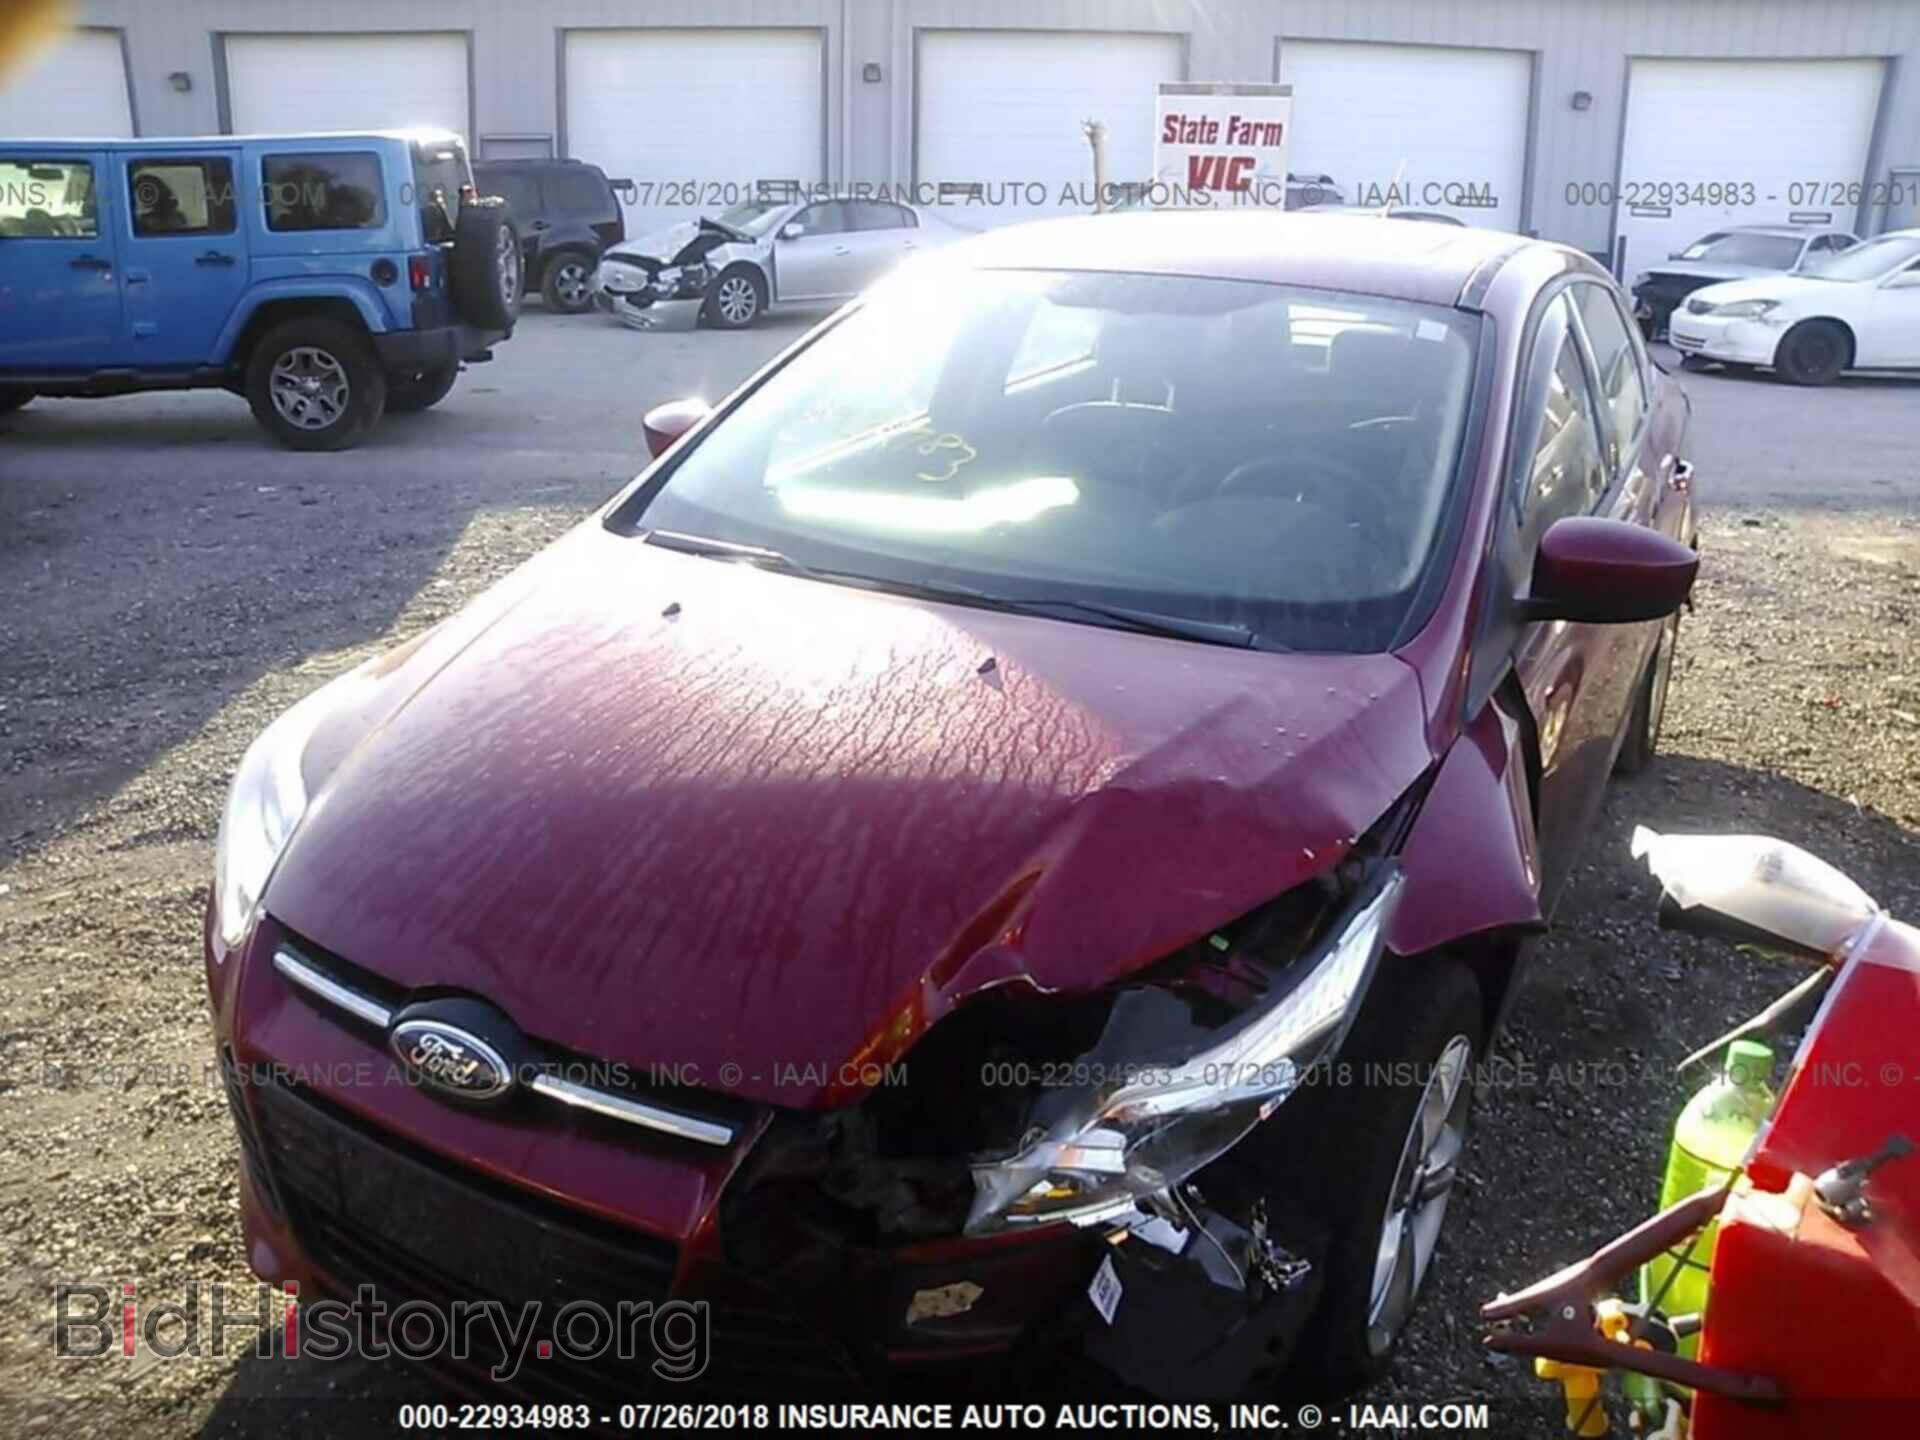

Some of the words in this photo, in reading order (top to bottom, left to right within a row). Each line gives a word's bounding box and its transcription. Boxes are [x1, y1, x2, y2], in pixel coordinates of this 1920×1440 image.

[1162, 113, 1219, 145] State
[1226, 115, 1283, 147] Farm
[1188, 155, 1256, 191] VIC
[410, 1033, 479, 1084] Ford
